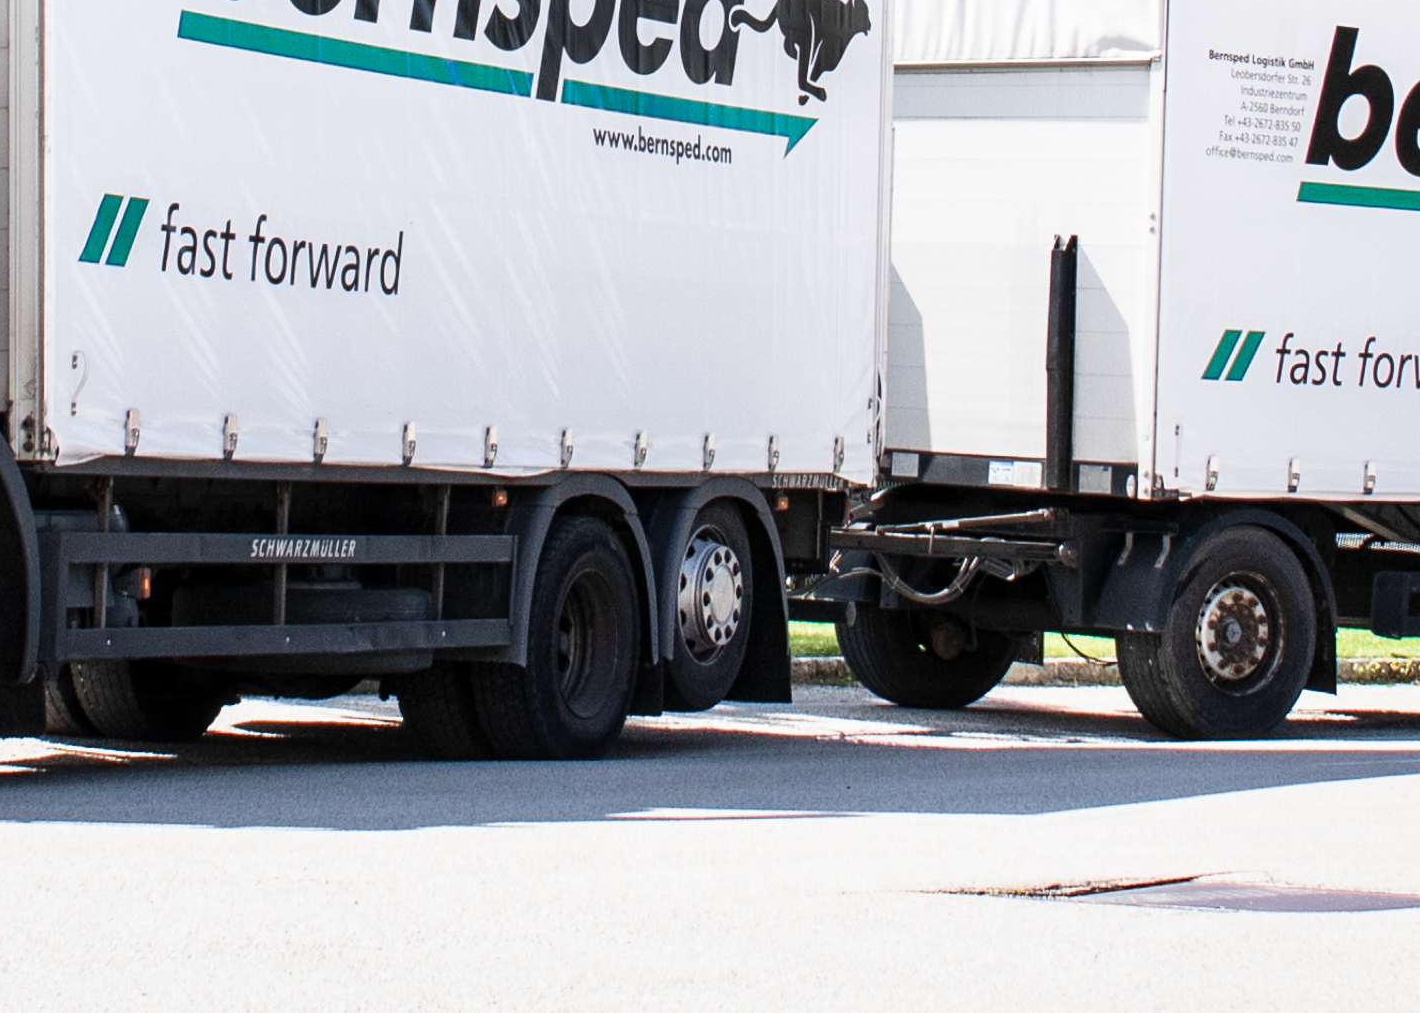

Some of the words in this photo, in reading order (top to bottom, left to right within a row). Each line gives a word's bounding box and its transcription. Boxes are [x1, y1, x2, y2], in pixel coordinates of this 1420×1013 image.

[1209, 49, 1250, 65] Bernsped
[1252, 54, 1286, 69] Logistik
[1289, 58, 1315, 70] GmbH
[1231, 68, 1286, 84] Leobersdorfer
[1288, 73, 1300, 85] Str.
[1302, 74, 1311, 86] 26
[1241, 85, 1308, 101] Industriezentrum
[1240, 100, 1269, 114] A-2560
[1270, 103, 1305, 117] Berndorf
[1224, 114, 1235, 126] Tel
[1238, 117, 1290, 132] +43-2672-835
[1291, 121, 1301, 133] 50
[593, 125, 732, 165] www.bernsped.com
[1219, 130, 1233, 142] Fax
[1235, 132, 1287, 147] +43-2672-835
[1289, 136, 1299, 148] 47
[1206, 145, 1294, 164] office@bernsped.com
[161, 202, 236, 281] fast
[249, 214, 404, 295] forward
[1276, 332, 1346, 386] fast
[250, 538, 356, 558] SCHWARZMÜLLER
